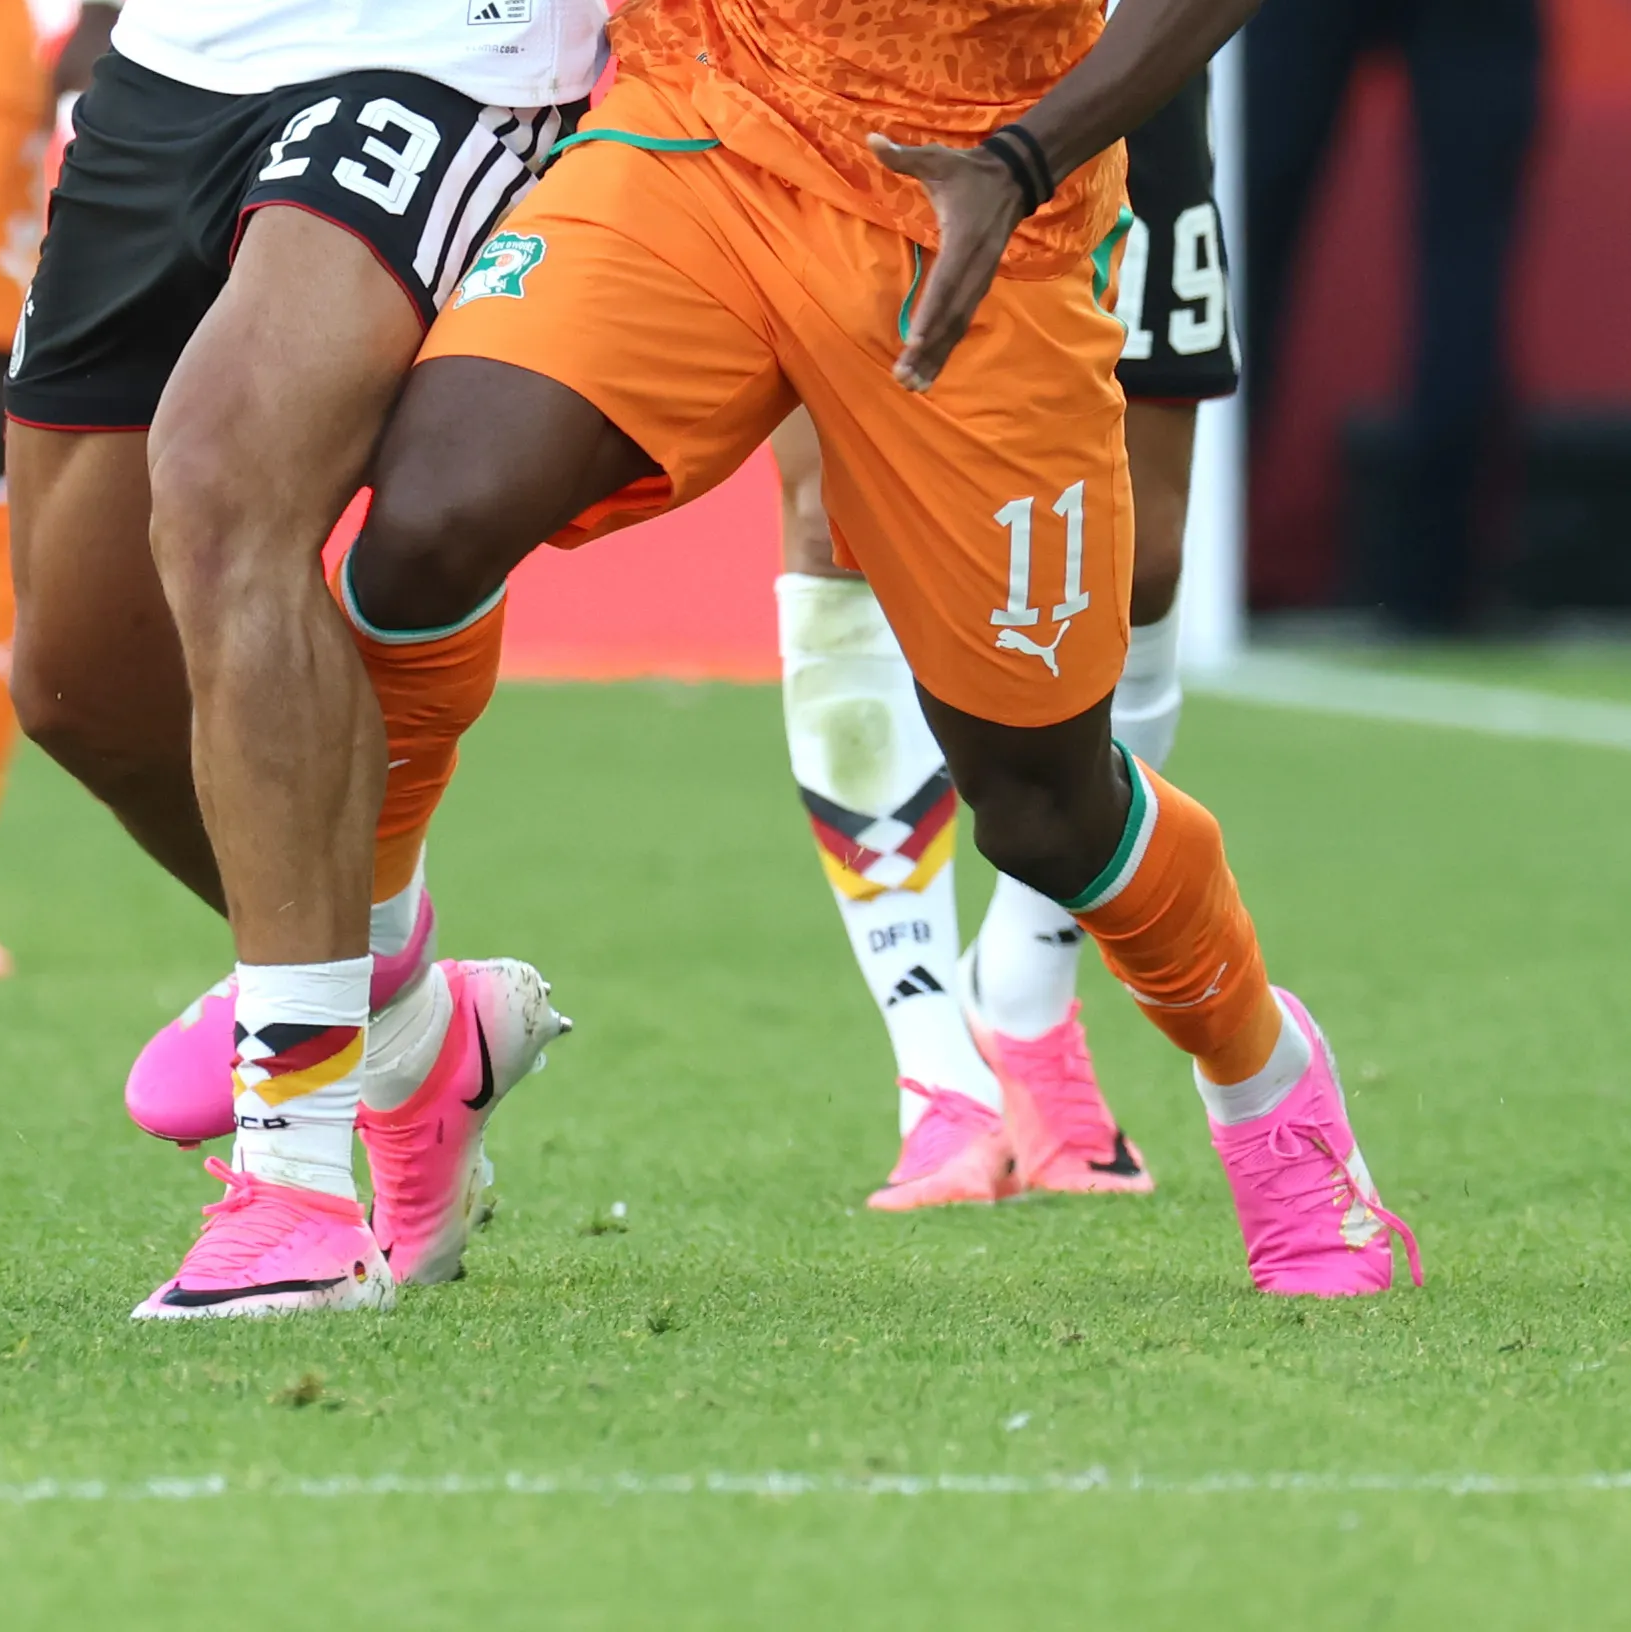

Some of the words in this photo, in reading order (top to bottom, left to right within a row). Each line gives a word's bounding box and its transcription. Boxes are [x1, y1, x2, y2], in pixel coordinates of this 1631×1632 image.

[259, 96, 441, 216] 23
[1117, 201, 1227, 360] 19
[990, 479, 1090, 626] 11
[868, 918, 931, 955] DFB
